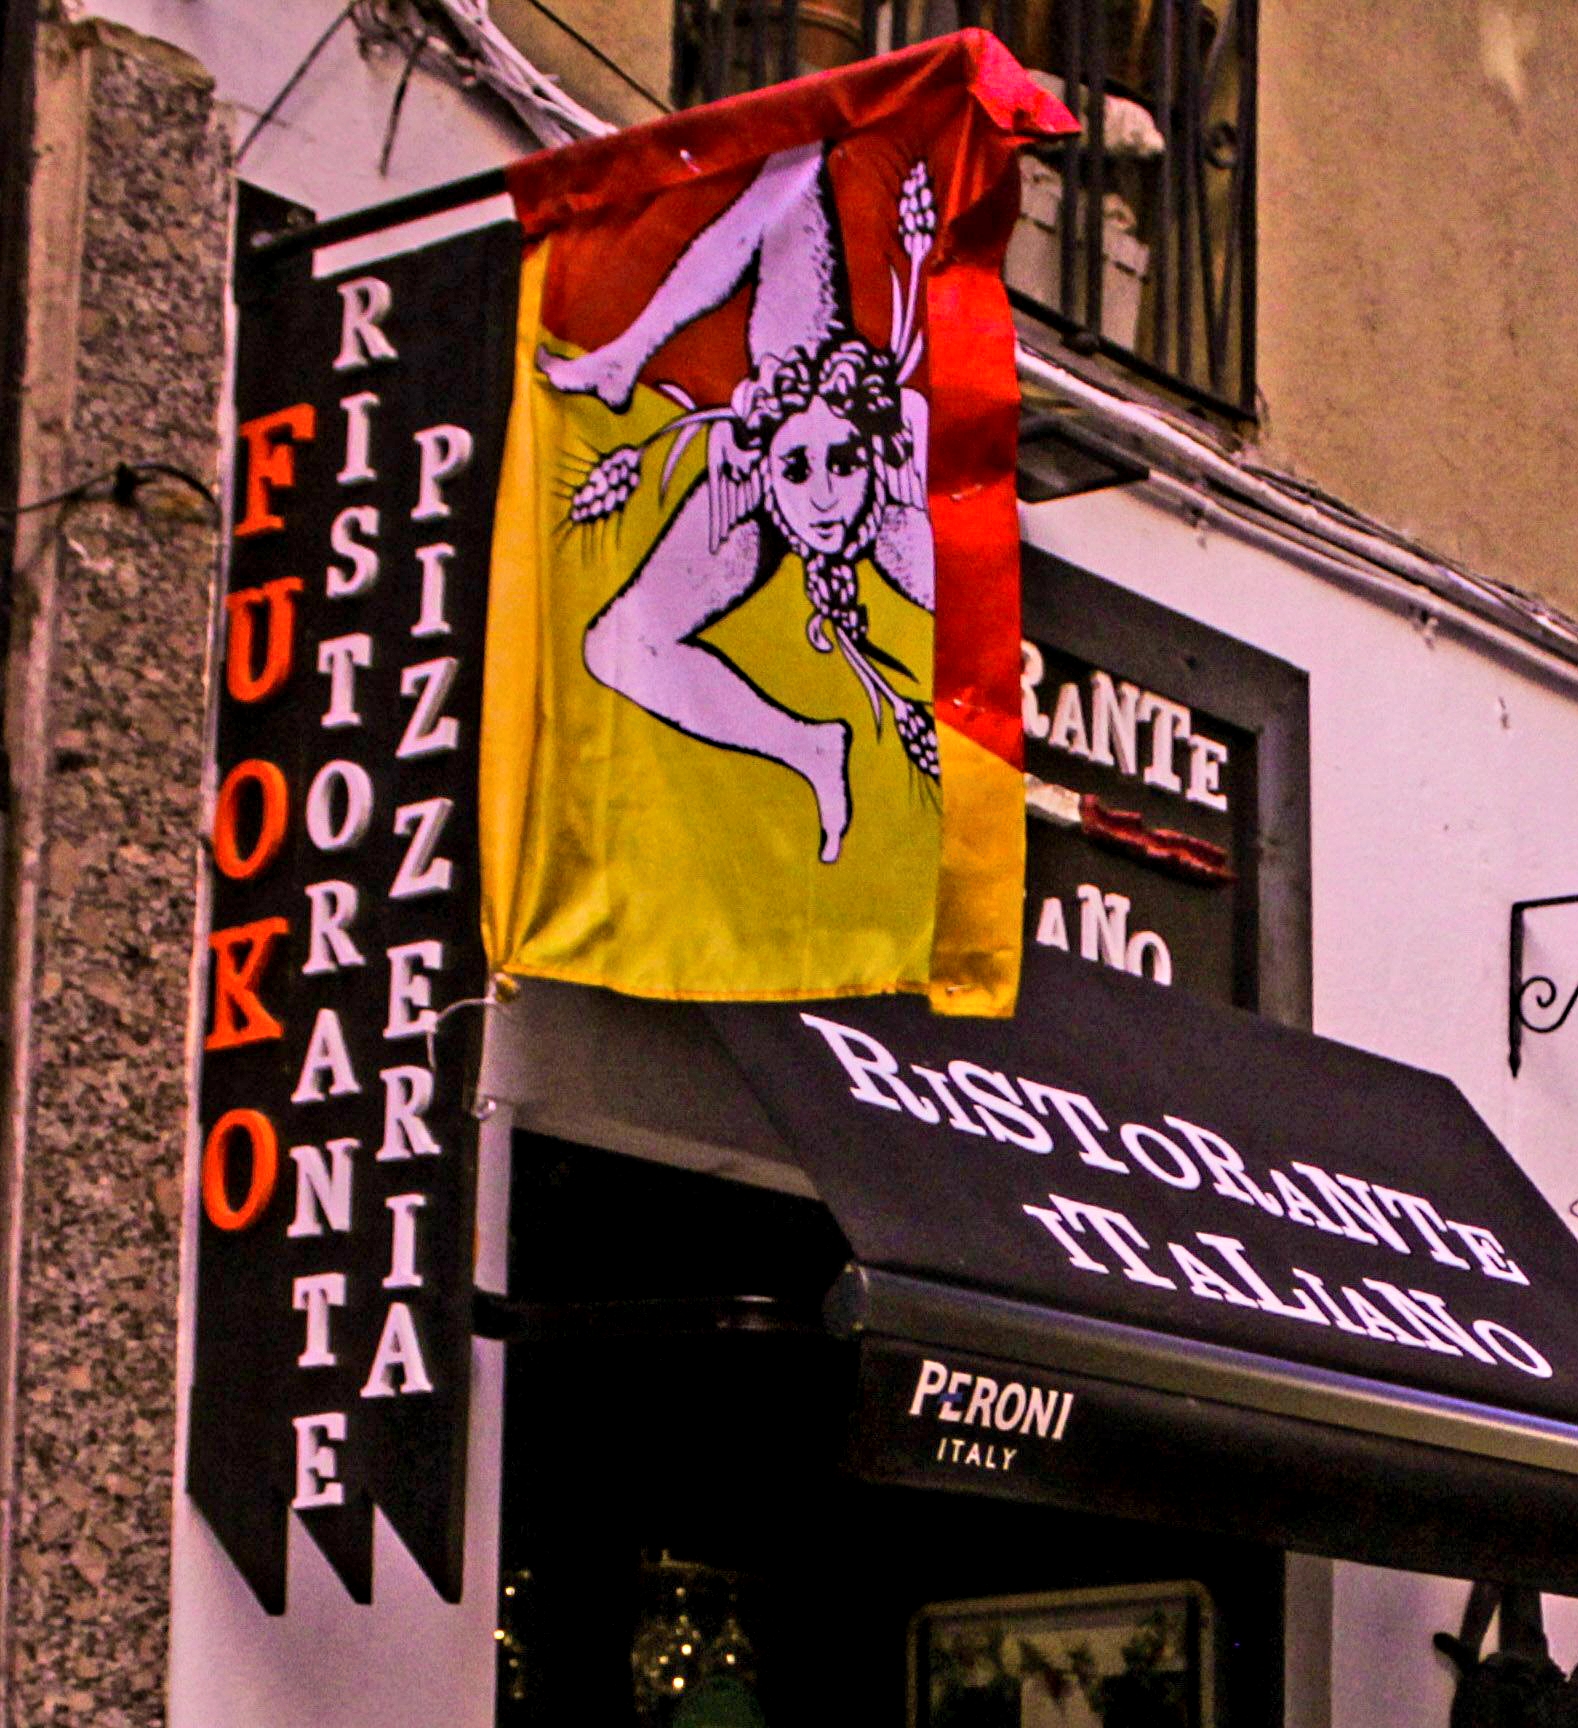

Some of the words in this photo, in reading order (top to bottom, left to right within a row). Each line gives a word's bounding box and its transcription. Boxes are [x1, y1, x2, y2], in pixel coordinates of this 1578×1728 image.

[202, 403, 315, 1230] FUOKO
[286, 276, 399, 1510] RISTORANTE
[360, 424, 474, 1399] PIZZERIA
[799, 1012, 1531, 1286] RISTORANTE
[1023, 1193, 1554, 1379] ITALIANO
[909, 1359, 1074, 1441] PERONI
[936, 1437, 1018, 1471] ITALY
